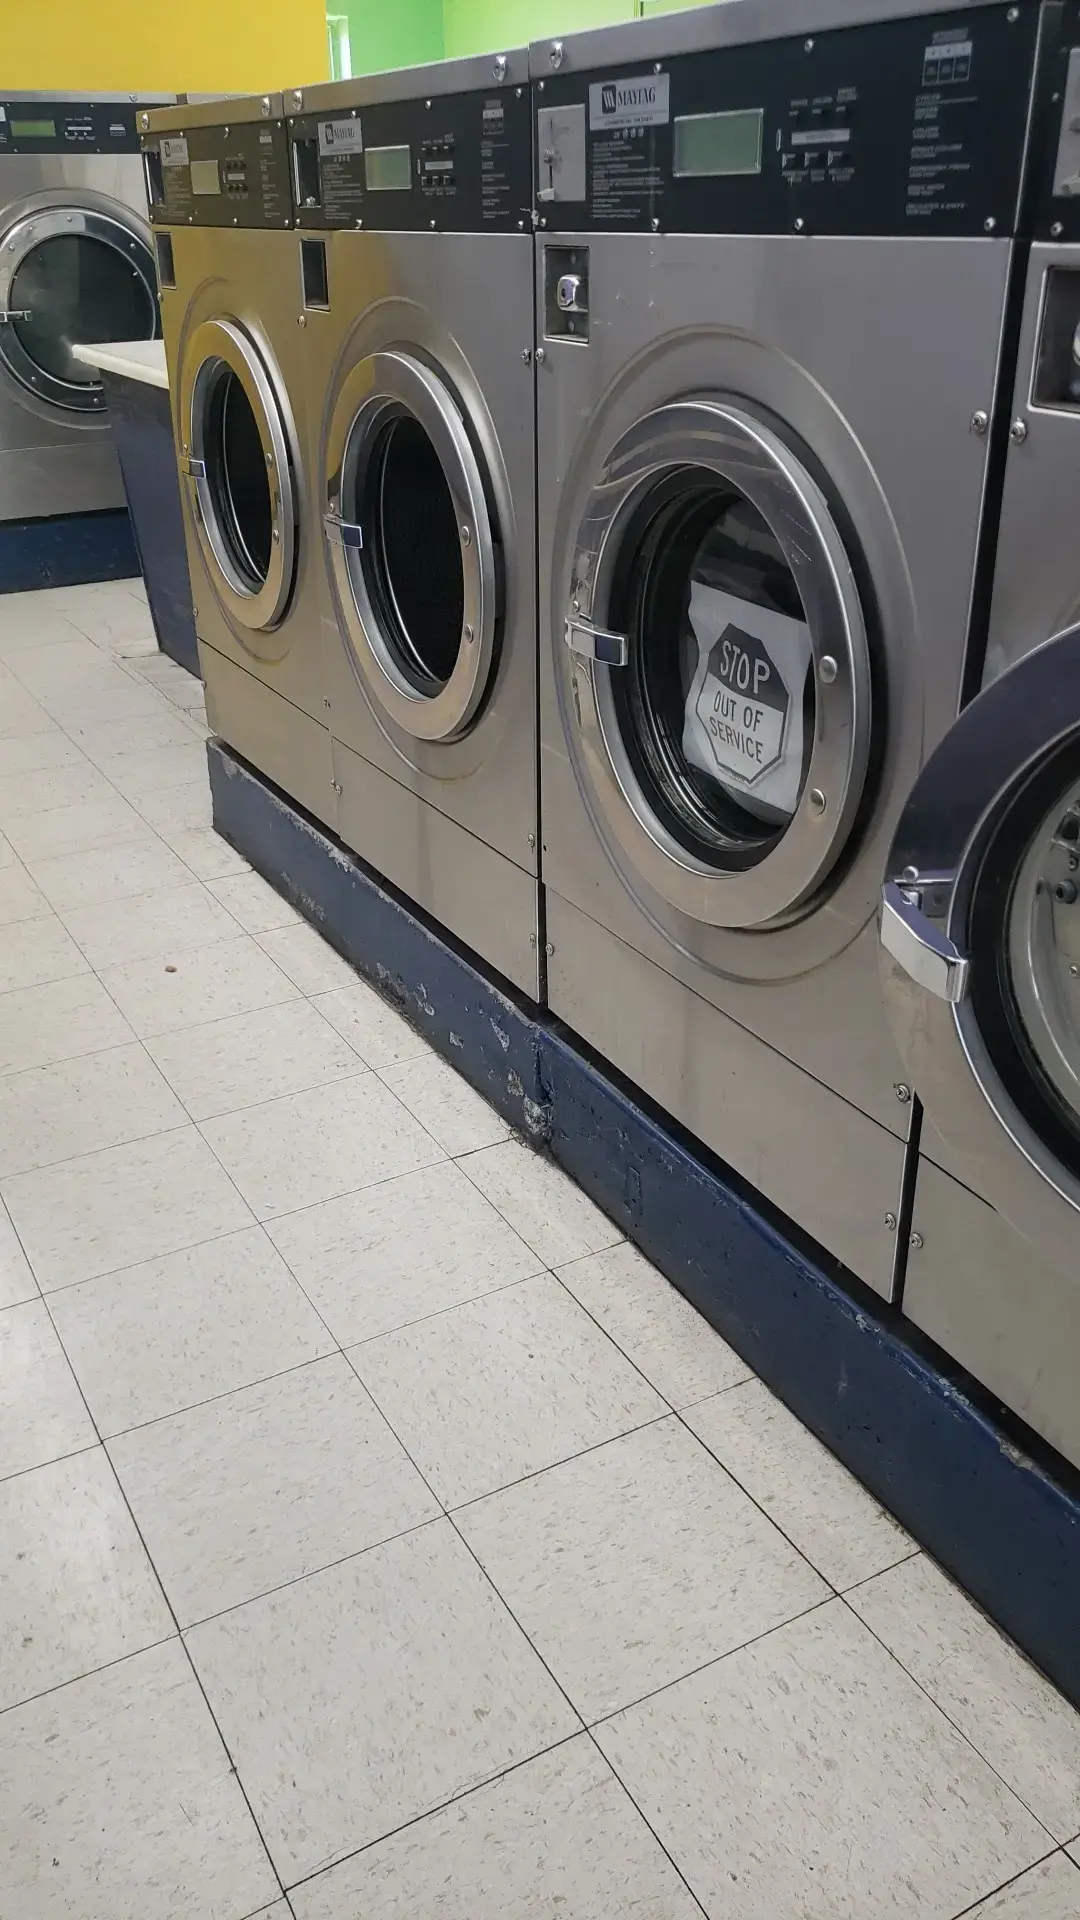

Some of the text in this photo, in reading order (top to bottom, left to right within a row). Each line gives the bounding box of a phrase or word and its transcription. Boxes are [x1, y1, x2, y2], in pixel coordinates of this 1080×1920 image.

[618, 86, 656, 107] MAYTAG
[720, 640, 771, 694] STOP
[713, 690, 764, 732] OUT OF
[709, 716, 764, 764] SERVICE
